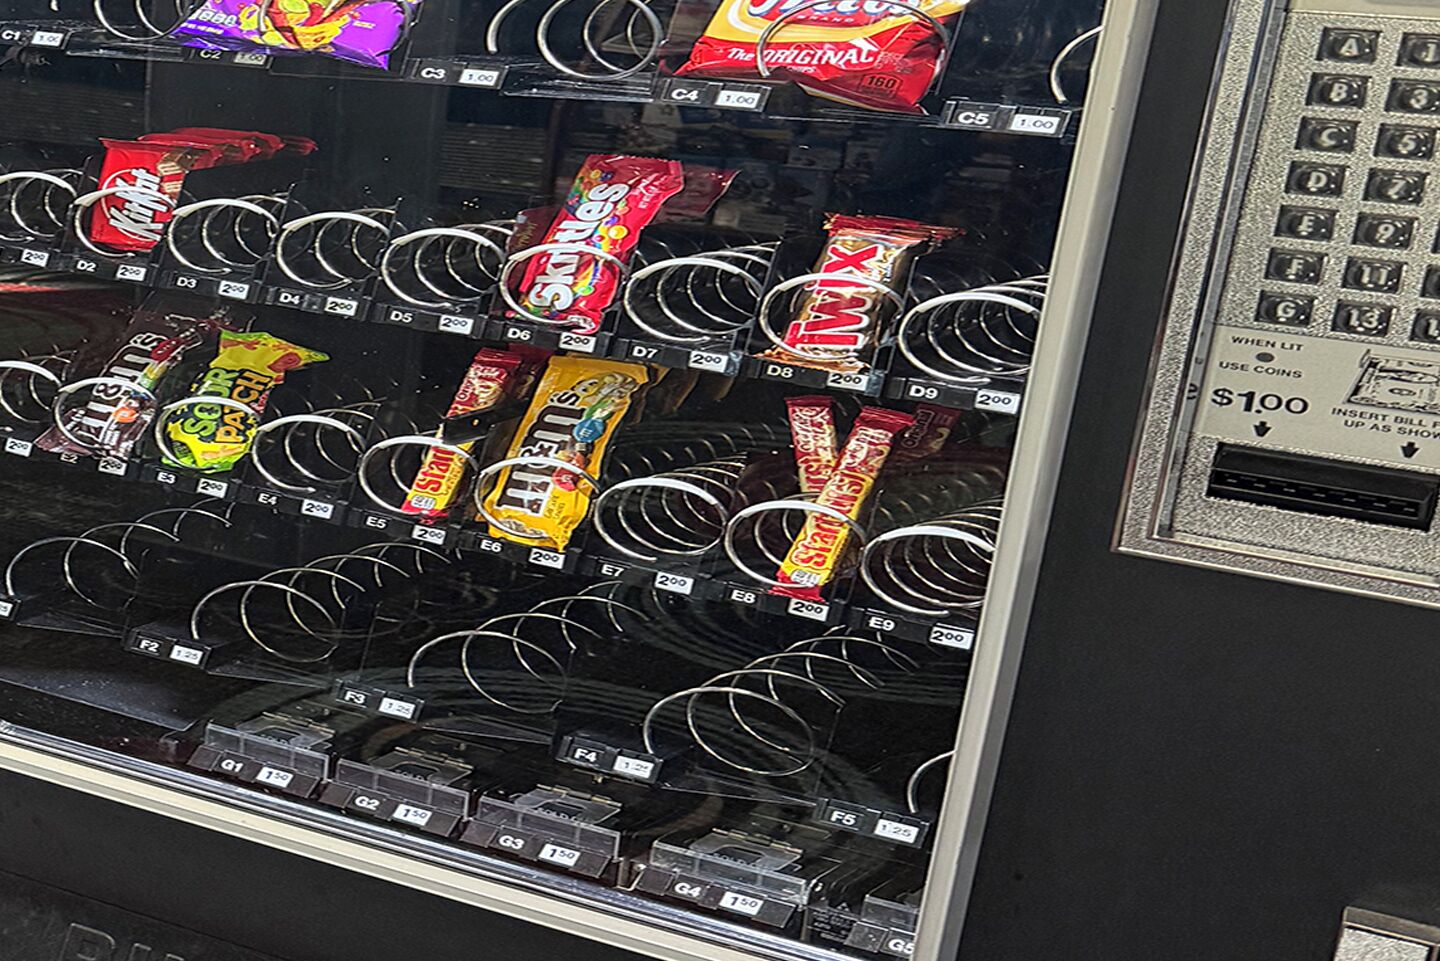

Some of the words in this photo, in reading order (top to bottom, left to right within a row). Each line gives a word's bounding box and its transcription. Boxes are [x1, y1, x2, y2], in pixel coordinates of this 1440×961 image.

[1, 29, 22, 41] C1
[726, 46, 755, 62] The
[420, 67, 447, 80] C3
[867, 74, 896, 89] 160
[671, 89, 699, 101] C4
[958, 111, 990, 125] C5
[76, 260, 97, 273] D2
[176, 276, 197, 288] D3
[279, 292, 301, 304] D4
[390, 311, 413, 323] D5
[506, 328, 531, 341] D6
[1231, 335, 1277, 349] WHEN
[1280, 341, 1305, 352] LIT
[632, 346, 659, 359] D7
[767, 366, 795, 380] D8
[1218, 361, 1250, 373] USE
[1253, 365, 1303, 379] COINS
[908, 387, 939, 400] D9
[1211, 386, 1309, 415] $1.00
[1331, 407, 1390, 422] INSERT
[1393, 415, 1428, 428] BILL
[1343, 419, 1366, 428] UP
[1369, 423, 1392, 433] AS
[60, 453, 79, 465] E2
[157, 472, 176, 485] E3
[258, 493, 278, 506] E4
[366, 516, 387, 530] E5
[480, 539, 503, 553] E6
[601, 564, 624, 577] E7
[730, 589, 757, 605] E8
[869, 617, 895, 632] E9
[138, 639, 160, 653] F2
[344, 690, 366, 704] F3
[573, 748, 598, 763] F4
[220, 759, 242, 773] G1
[354, 795, 380, 811] G2
[830, 810, 857, 826] F5
[499, 835, 526, 850] G3
[673, 882, 702, 898] G4
